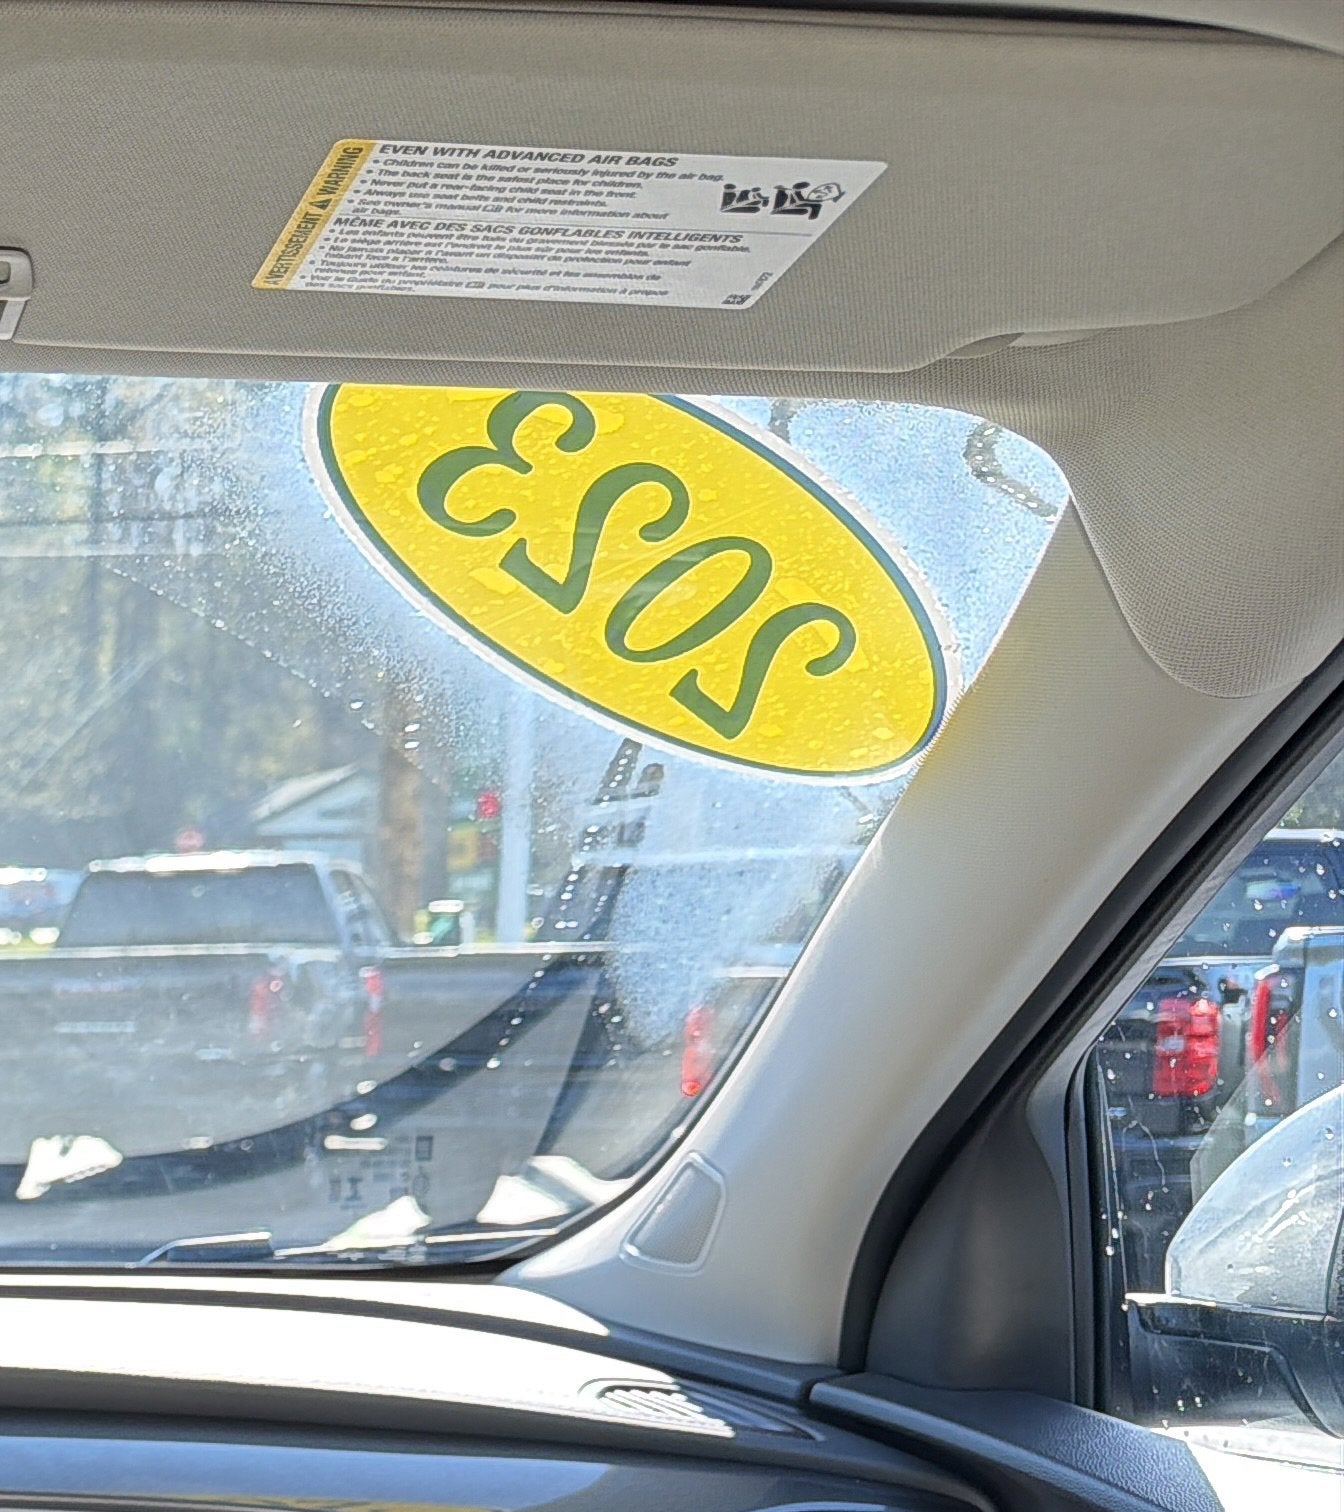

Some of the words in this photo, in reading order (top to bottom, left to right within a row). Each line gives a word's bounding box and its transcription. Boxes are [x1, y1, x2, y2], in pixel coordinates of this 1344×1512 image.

[316, 147, 363, 196] WARNING
[378, 144, 428, 156] EVEN
[431, 146, 480, 158] WITH
[483, 149, 585, 164] ADVANCED
[587, 154, 623, 165] AIR
[625, 156, 679, 167] BAGS
[263, 211, 324, 286] AVERTISSEMENT
[332, 216, 383, 228] MÊME
[387, 220, 431, 230] AVEC
[433, 222, 468, 231] DES
[470, 223, 515, 236] SACS
[518, 226, 625, 240] GONFLABLES
[627, 230, 743, 244] INTELLIGENTS
